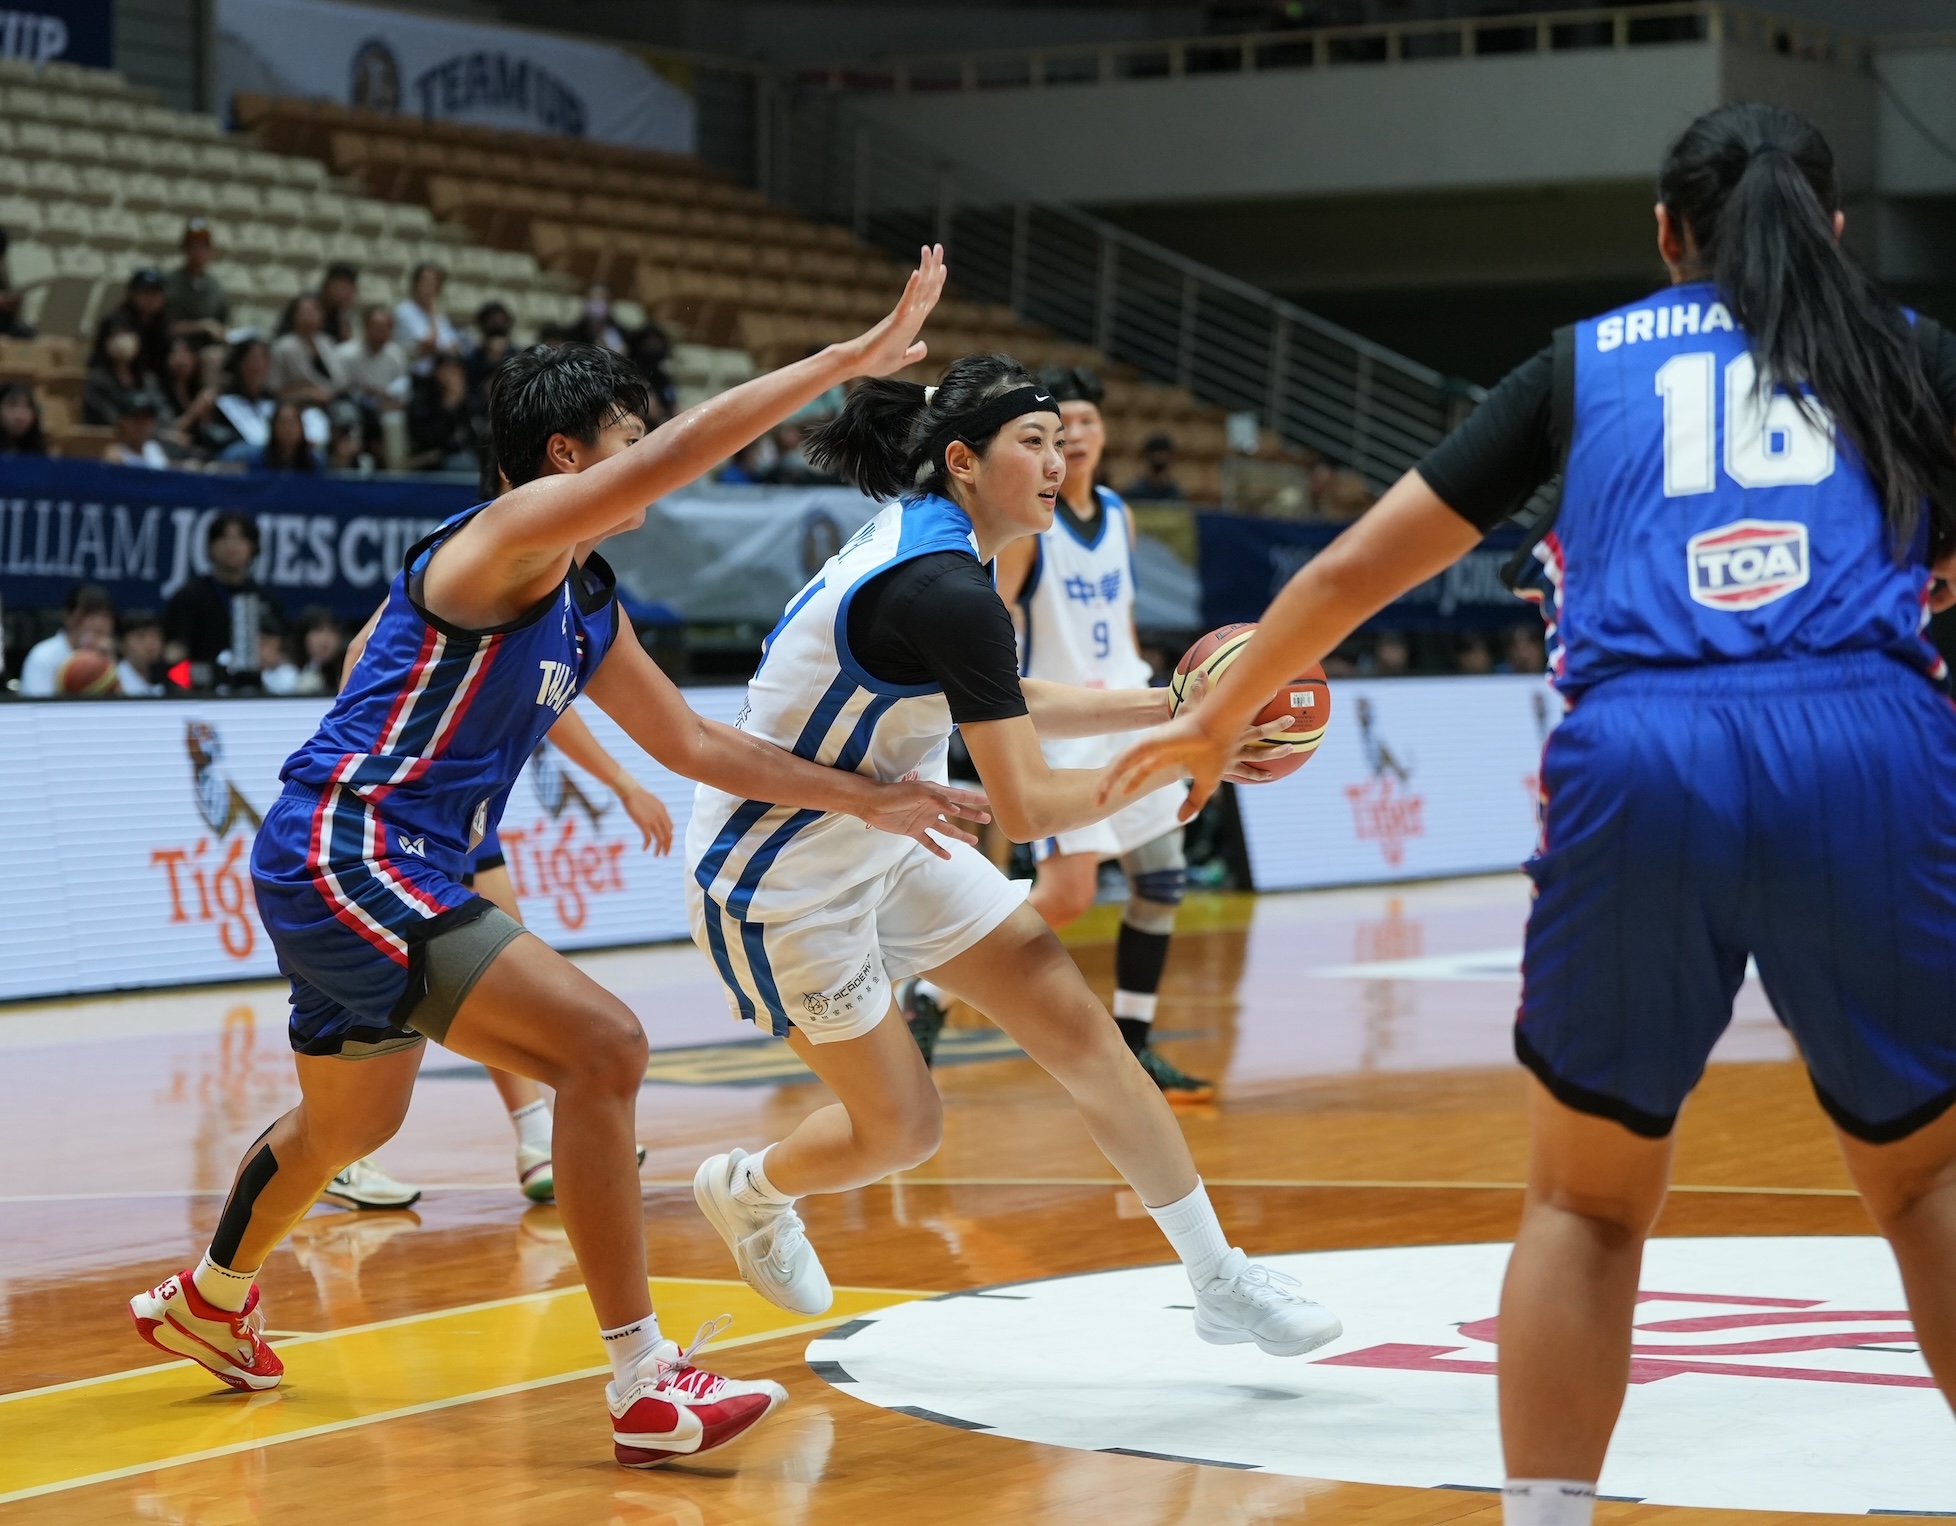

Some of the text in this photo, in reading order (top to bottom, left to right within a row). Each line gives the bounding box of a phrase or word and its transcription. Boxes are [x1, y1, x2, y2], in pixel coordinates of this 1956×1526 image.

[0, 10, 69, 65] UP
[1596, 302, 1744, 352] SRIHA
[1655, 351, 1836, 498] 16
[338, 515, 440, 589] CU
[1698, 545, 1801, 588] TOA
[1093, 621, 1110, 659] 9
[150, 836, 257, 959] Tig
[833, 961, 872, 1001] ACADEMY
[601, 1325, 642, 1341] ARRIX
